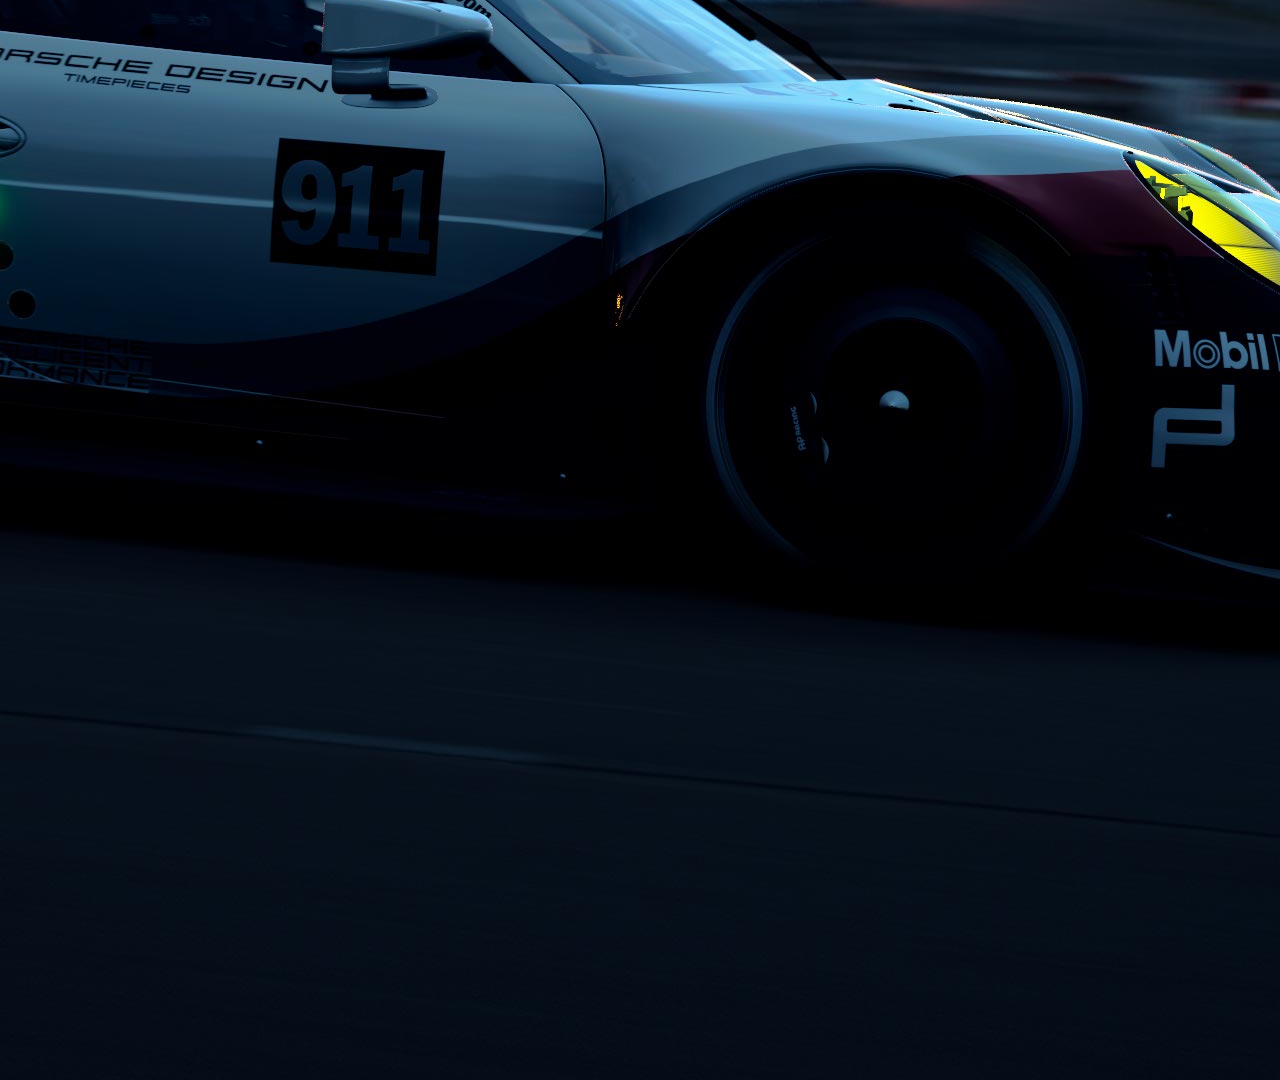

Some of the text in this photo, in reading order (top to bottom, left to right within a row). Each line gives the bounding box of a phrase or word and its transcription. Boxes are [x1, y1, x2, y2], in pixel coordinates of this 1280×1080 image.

[64, 73, 191, 93] TIMEPIECES
[165, 64, 328, 92] DESIGN
[281, 159, 431, 255] 911
[1154, 329, 1270, 370] Mobil
